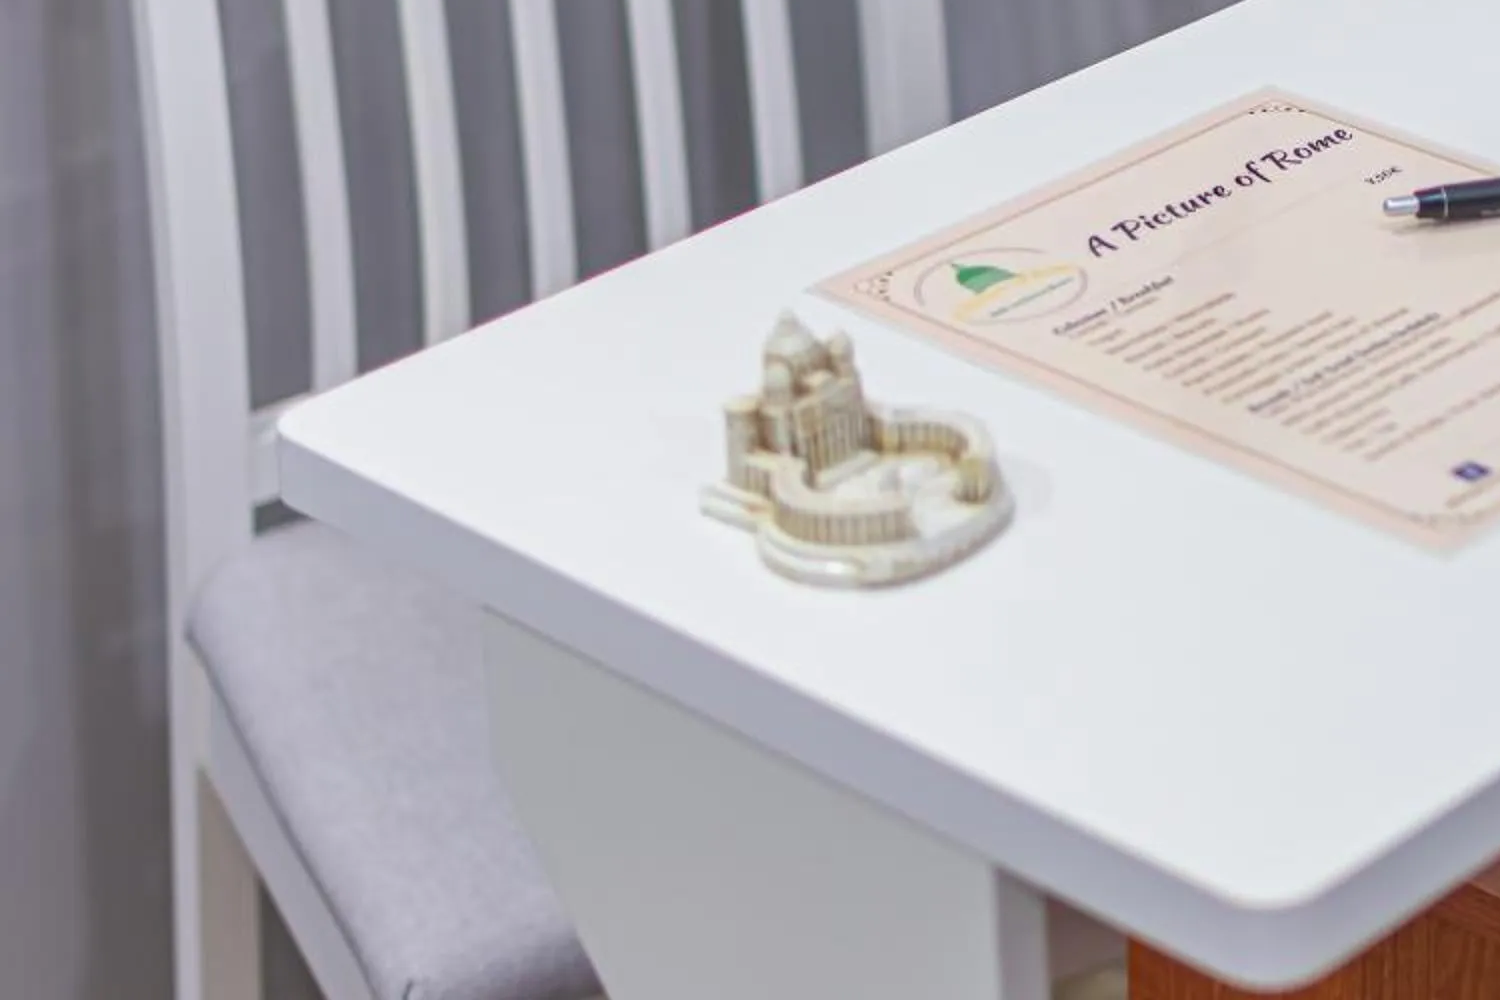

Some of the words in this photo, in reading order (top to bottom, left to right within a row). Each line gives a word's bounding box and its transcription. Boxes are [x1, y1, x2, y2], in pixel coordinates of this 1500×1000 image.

[1087, 233, 1118, 258] A
[1111, 183, 1233, 241] Picture
[1235, 160, 1273, 188] of
[1260, 127, 1354, 171] Rome
